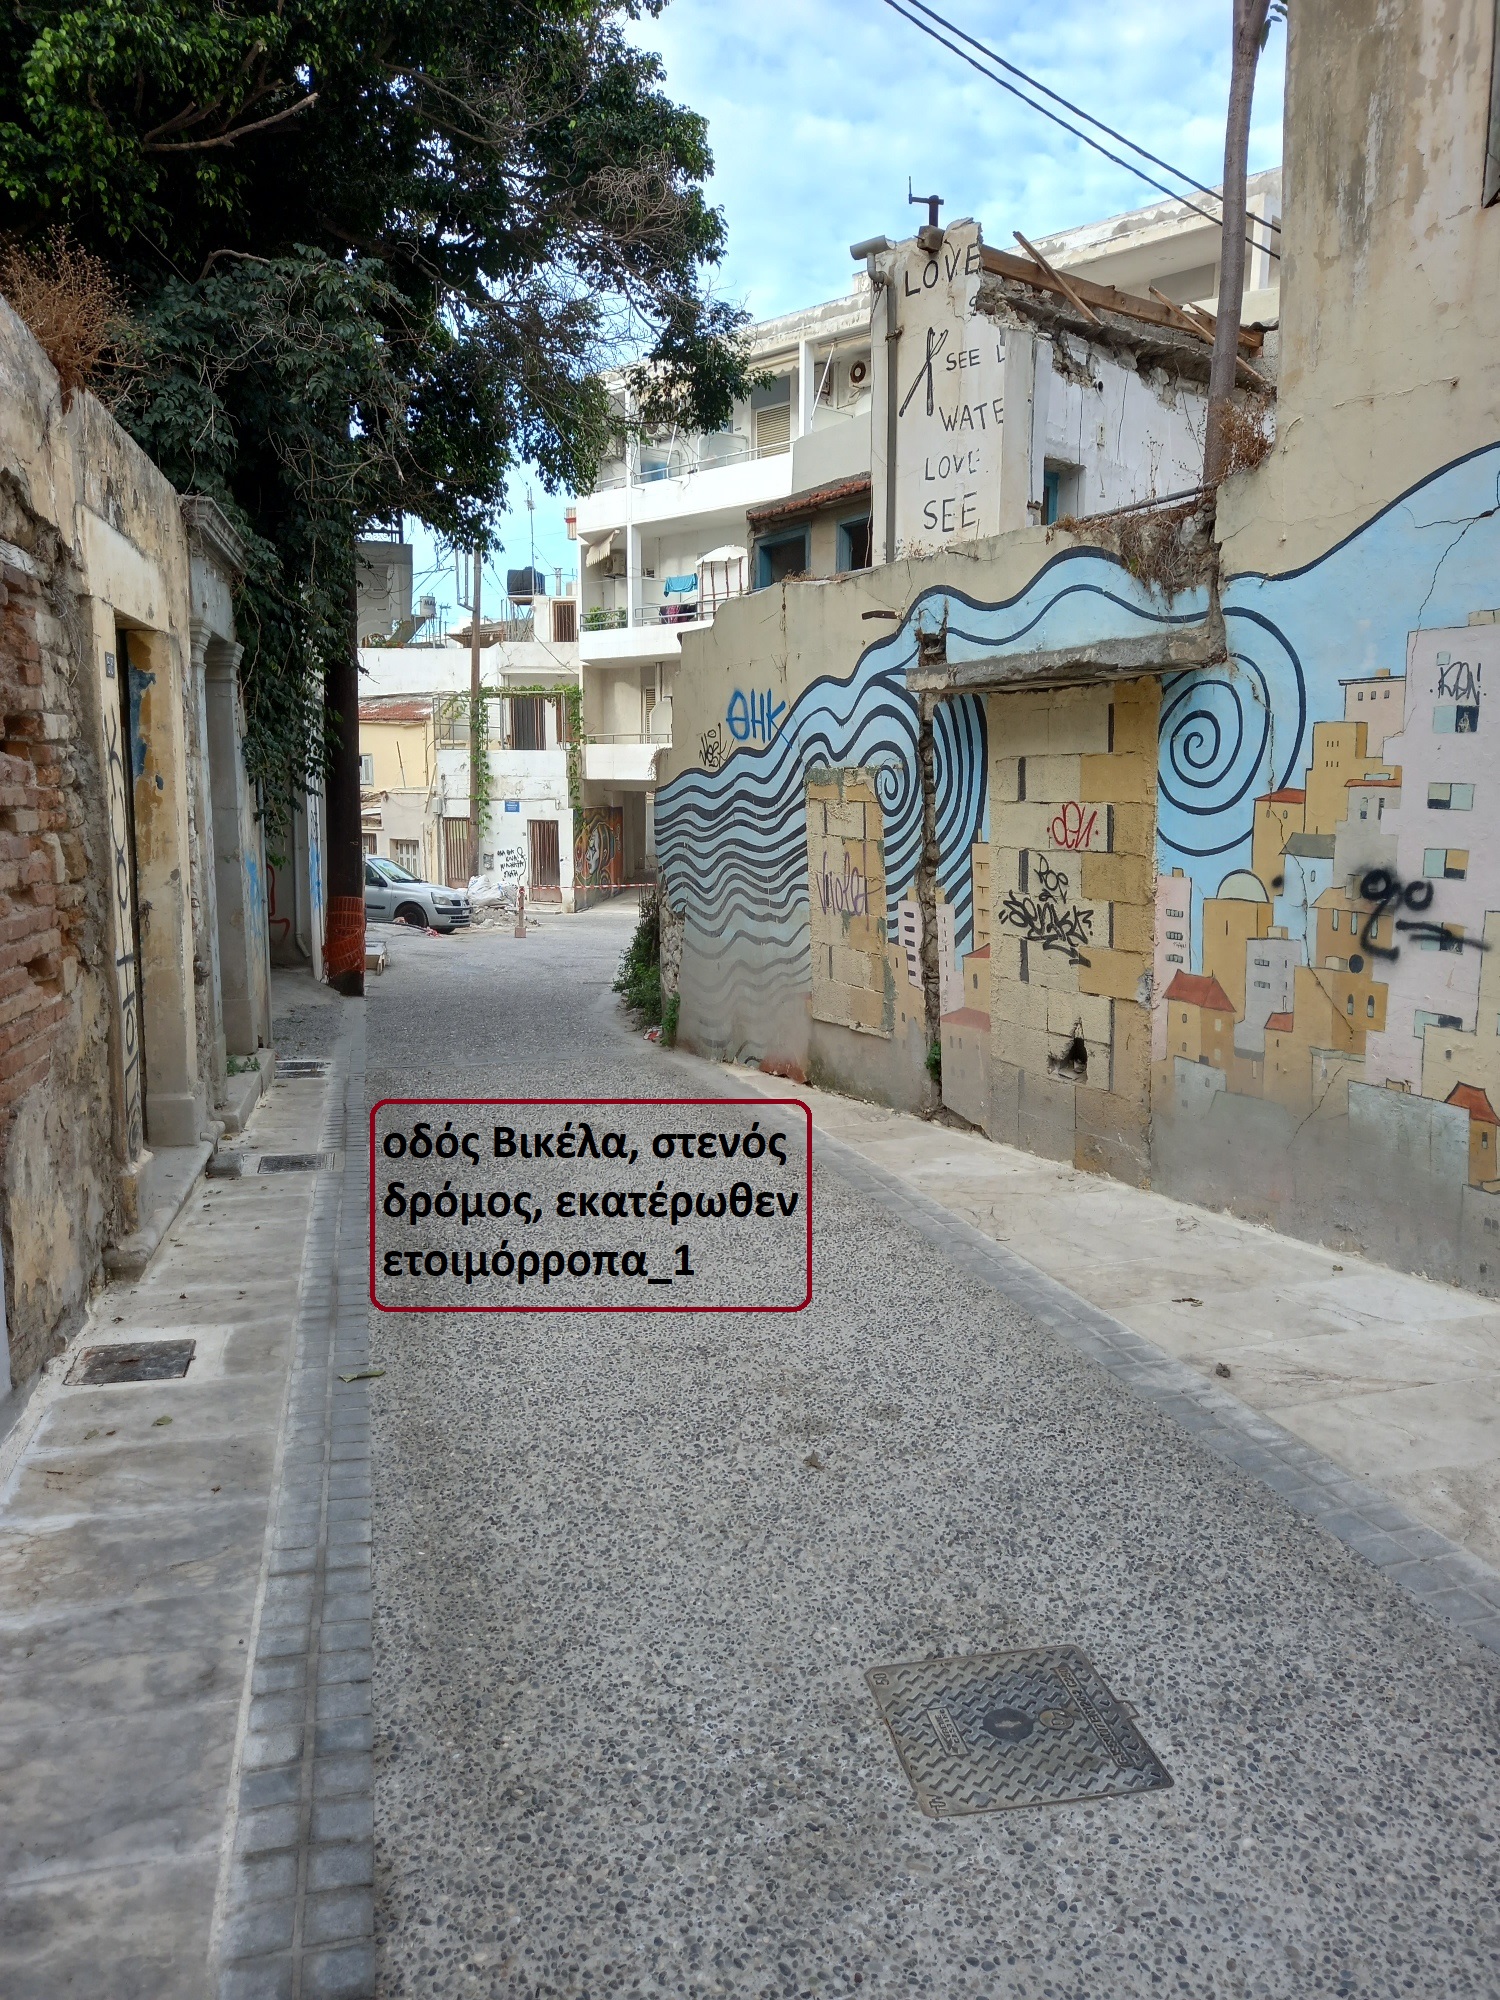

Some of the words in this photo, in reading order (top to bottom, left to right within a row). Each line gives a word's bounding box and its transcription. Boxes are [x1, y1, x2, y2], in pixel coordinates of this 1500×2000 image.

[905, 242, 980, 297] LOVE
[946, 348, 980, 371] SEE
[923, 490, 978, 532] SEE
